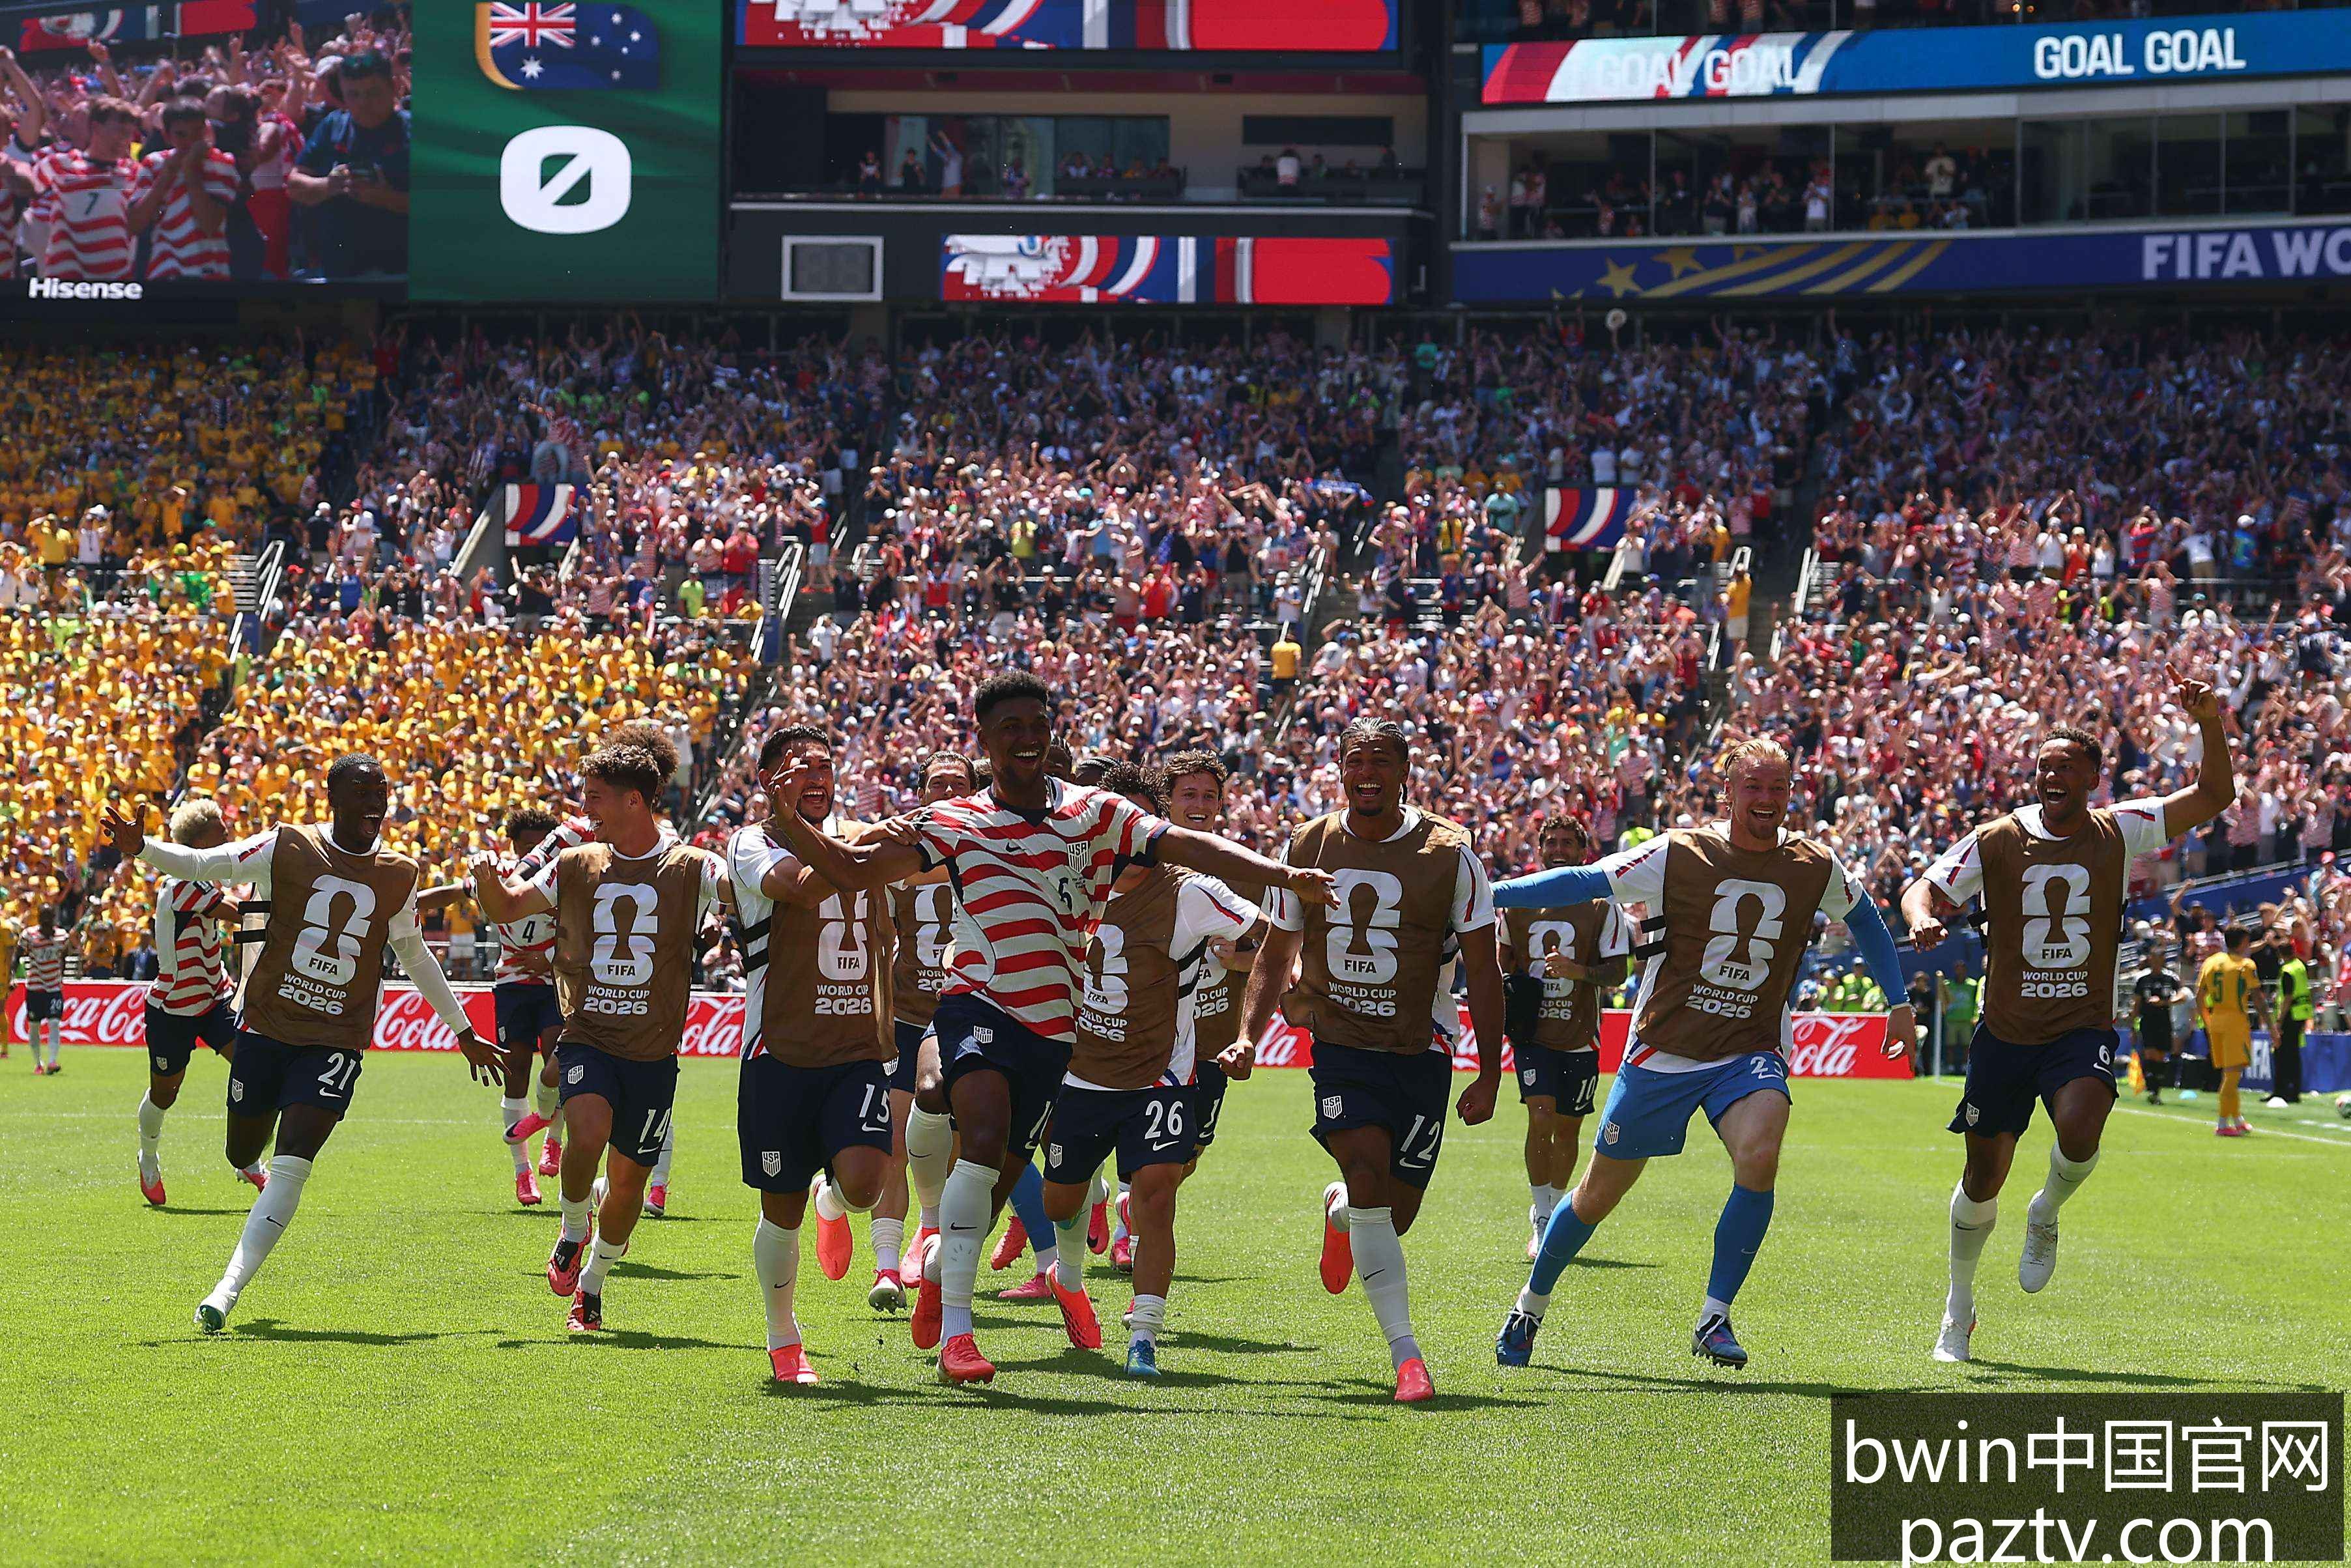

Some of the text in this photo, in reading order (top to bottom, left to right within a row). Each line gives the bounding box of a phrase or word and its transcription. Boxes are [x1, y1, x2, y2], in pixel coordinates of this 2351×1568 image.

[2034, 27, 2247, 79] GOAL GOAL
[1705, 45, 1799, 91] GOAL
[85, 192, 99, 214] 7
[2143, 233, 2264, 279] FIFA
[29, 277, 143, 300] Hisense
[1068, 842, 1087, 856] USA
[522, 920, 535, 943] 4
[837, 957, 860, 969] FIFA
[2042, 948, 2073, 959] FIFA
[309, 958, 338, 975] FIFA
[607, 965, 636, 976] FIFA
[1345, 959, 1376, 973] FIFA
[1719, 965, 1750, 981] FIFA
[918, 978, 944, 991] 20
[2023, 971, 2088, 981] WORLD CUP
[284, 973, 347, 999] WORLD CUP
[588, 985, 650, 999] WORLD CUP
[816, 984, 869, 996] WORLD CUP
[1209, 986, 1228, 999] CUP
[1328, 982, 1397, 999] WORLD CUP
[1694, 984, 1758, 1004] WORLD CUP
[2021, 982, 2088, 998] 2026
[278, 984, 344, 1015] 2026
[583, 996, 648, 1015] 2026
[815, 997, 872, 1016] 2026
[1193, 998, 1229, 1019] 026
[1685, 995, 1751, 1018] 2026
[1081, 1007, 1128, 1028] ORLD CUP
[1538, 1007, 1572, 1020] 026
[975, 1027, 991, 1035] USA
[1078, 1016, 1125, 1042] 026
[2099, 1045, 2110, 1066] 6
[318, 1052, 356, 1090] 21
[1576, 1076, 1596, 1103] 10
[859, 1083, 889, 1123] 15
[1323, 1096, 1341, 1107] USA
[639, 1107, 671, 1143] 14
[1145, 1100, 1183, 1139] 26
[1400, 1114, 1440, 1161] 12
[763, 1152, 780, 1162] USA
